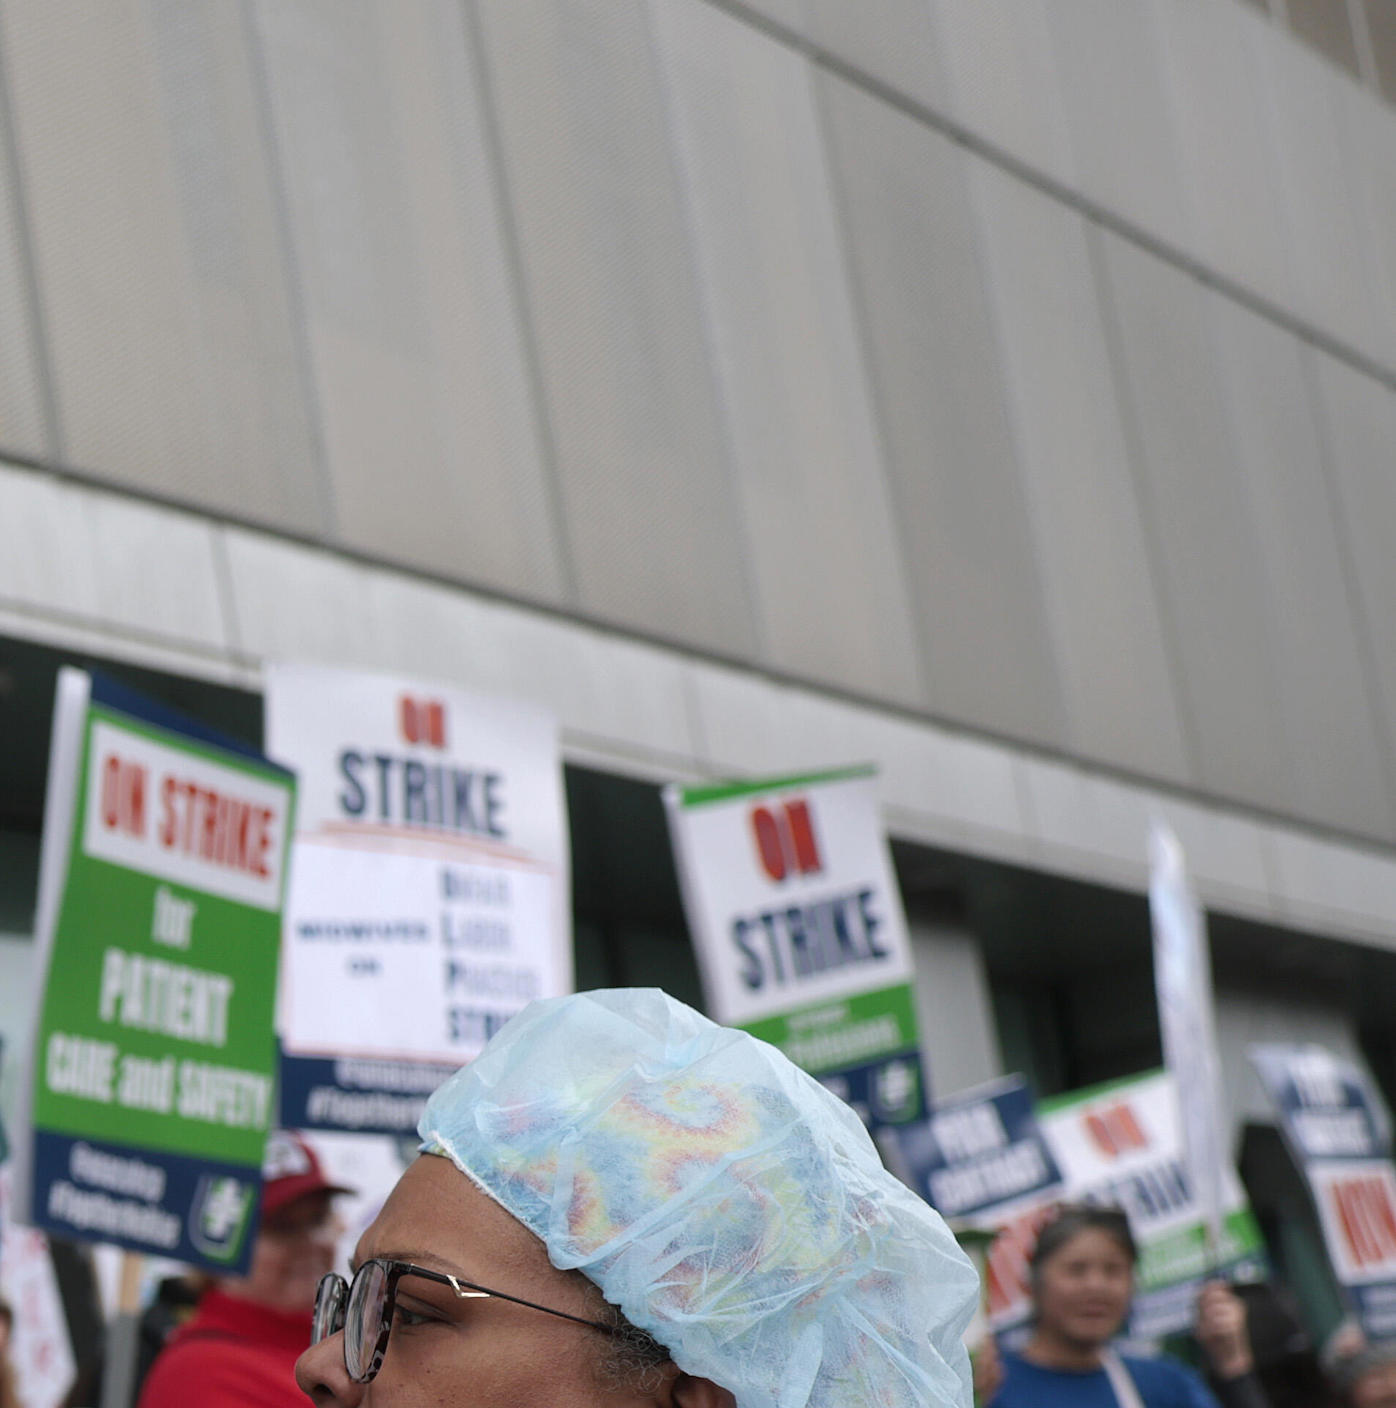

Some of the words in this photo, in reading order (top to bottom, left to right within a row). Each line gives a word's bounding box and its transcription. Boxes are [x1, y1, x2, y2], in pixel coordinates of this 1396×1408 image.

[101, 752, 148, 838] ON
[158, 774, 275, 880] STRIKE
[338, 746, 506, 839] STRIKE
[747, 796, 825, 883] ON
[731, 887, 893, 993] STRIKE
